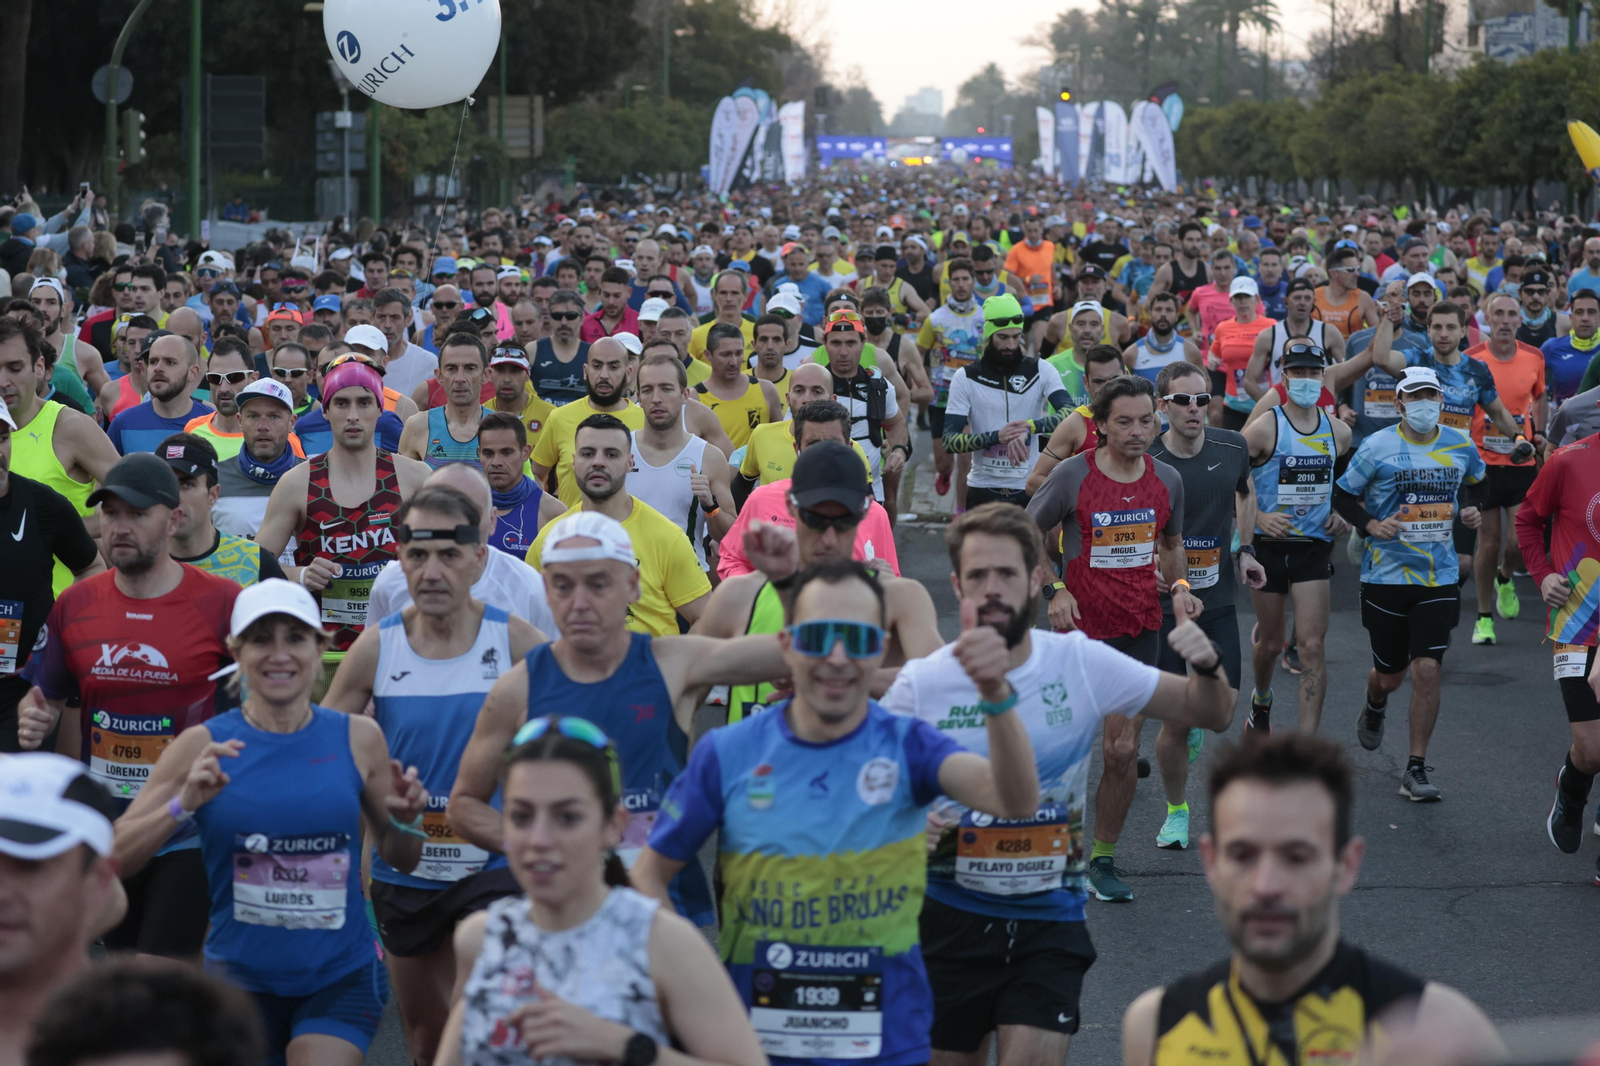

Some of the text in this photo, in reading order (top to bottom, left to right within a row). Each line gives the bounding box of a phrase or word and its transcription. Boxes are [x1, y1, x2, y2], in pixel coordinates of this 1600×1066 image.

[1445, 404, 1470, 414] ZURICH
[1297, 457, 1326, 466] ZURICH
[1297, 473, 1316, 482] 2010
[1418, 494, 1448, 502] ZURICH
[1113, 512, 1148, 524] ZURICH
[1419, 510, 1437, 518] 4218
[1420, 522, 1444, 530] CUERPO
[320, 527, 396, 554] KENYA
[1114, 532, 1136, 542] 3793
[1110, 546, 1138, 555] MIGUEL
[91, 666, 115, 676] MEDIA
[116, 668, 129, 677] DE
[129, 668, 142, 678] LA
[143, 670, 179, 682] PUEBLA
[111, 717, 162, 731] ZURICH
[112, 744, 142, 759] 4769
[105, 763, 149, 778] LORENZO
[271, 837, 336, 852] ZURICH
[995, 838, 1032, 853] 4288
[968, 860, 1055, 873] PELAYO DGUEZ
[265, 892, 314, 905] LURDES
[791, 897, 822, 929] DE
[795, 950, 869, 968] ZURICH
[795, 985, 841, 1006] 1939
[782, 1015, 850, 1030] JUANCHO
